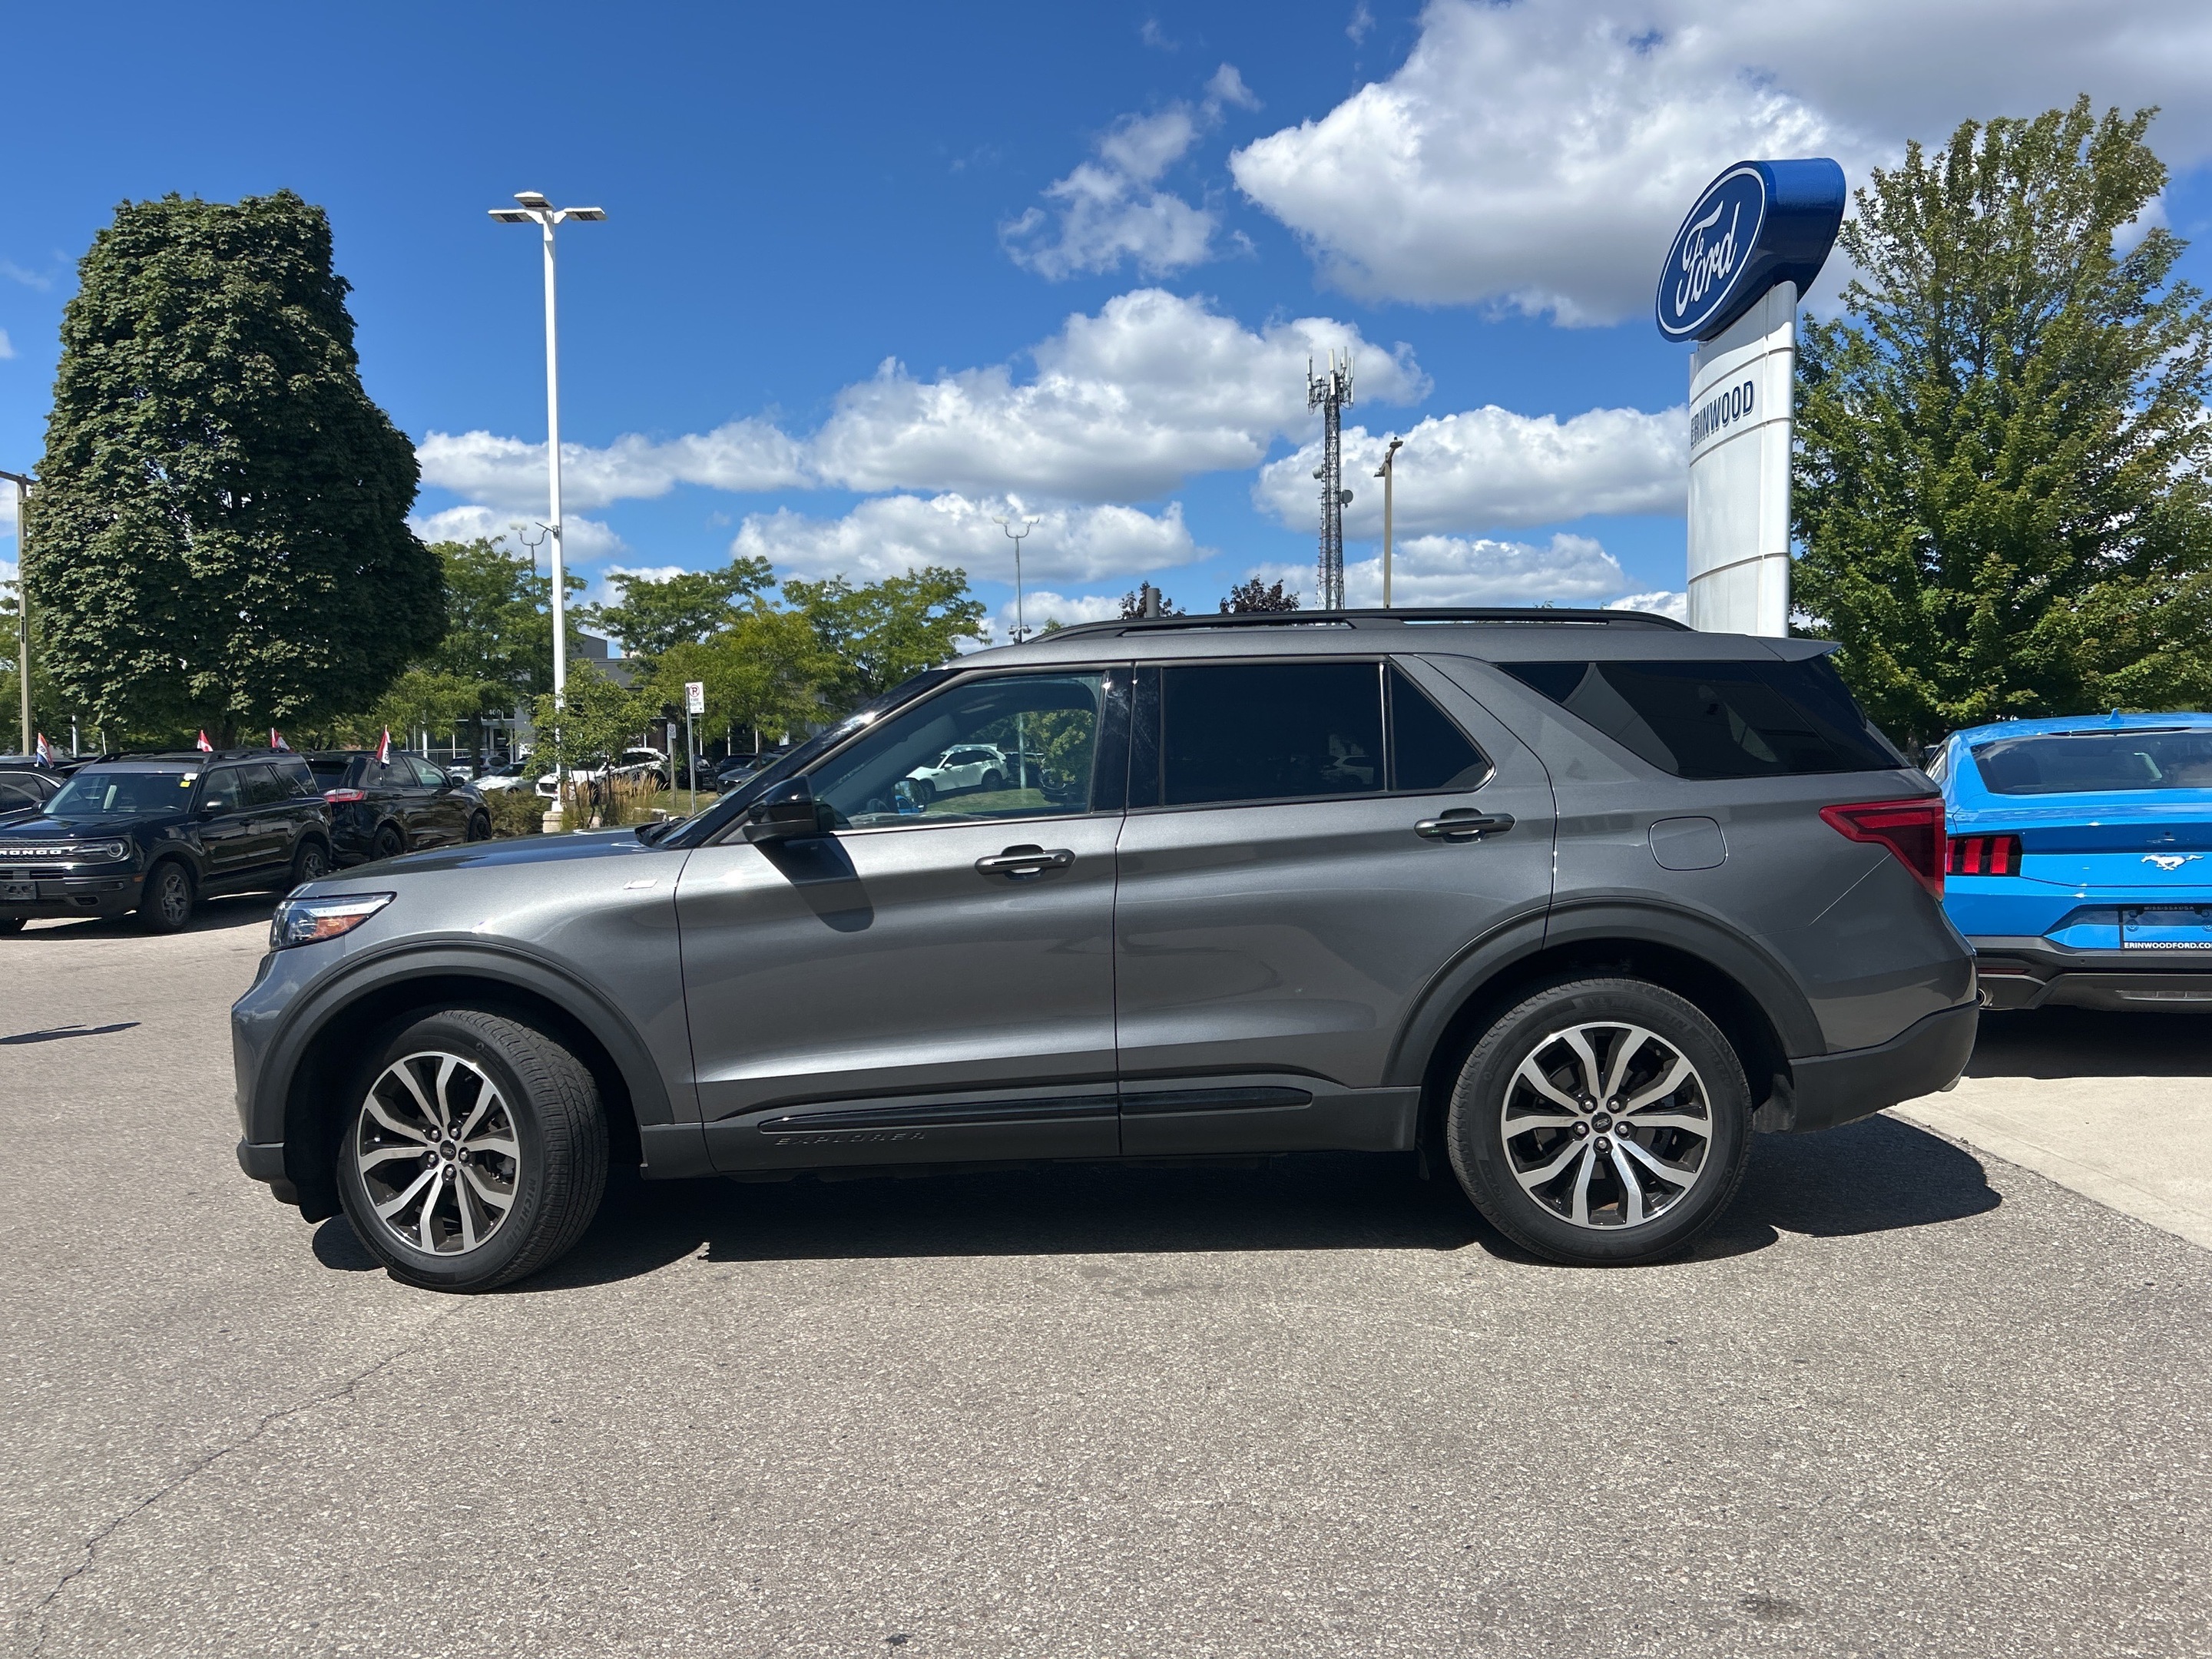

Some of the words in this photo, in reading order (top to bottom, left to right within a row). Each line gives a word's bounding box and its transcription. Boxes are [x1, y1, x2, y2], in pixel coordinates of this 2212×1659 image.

[1676, 200, 1740, 317] Ford
[1690, 380, 1754, 451] ERINWOOD
[774, 1132, 925, 1145] EXPLORER
